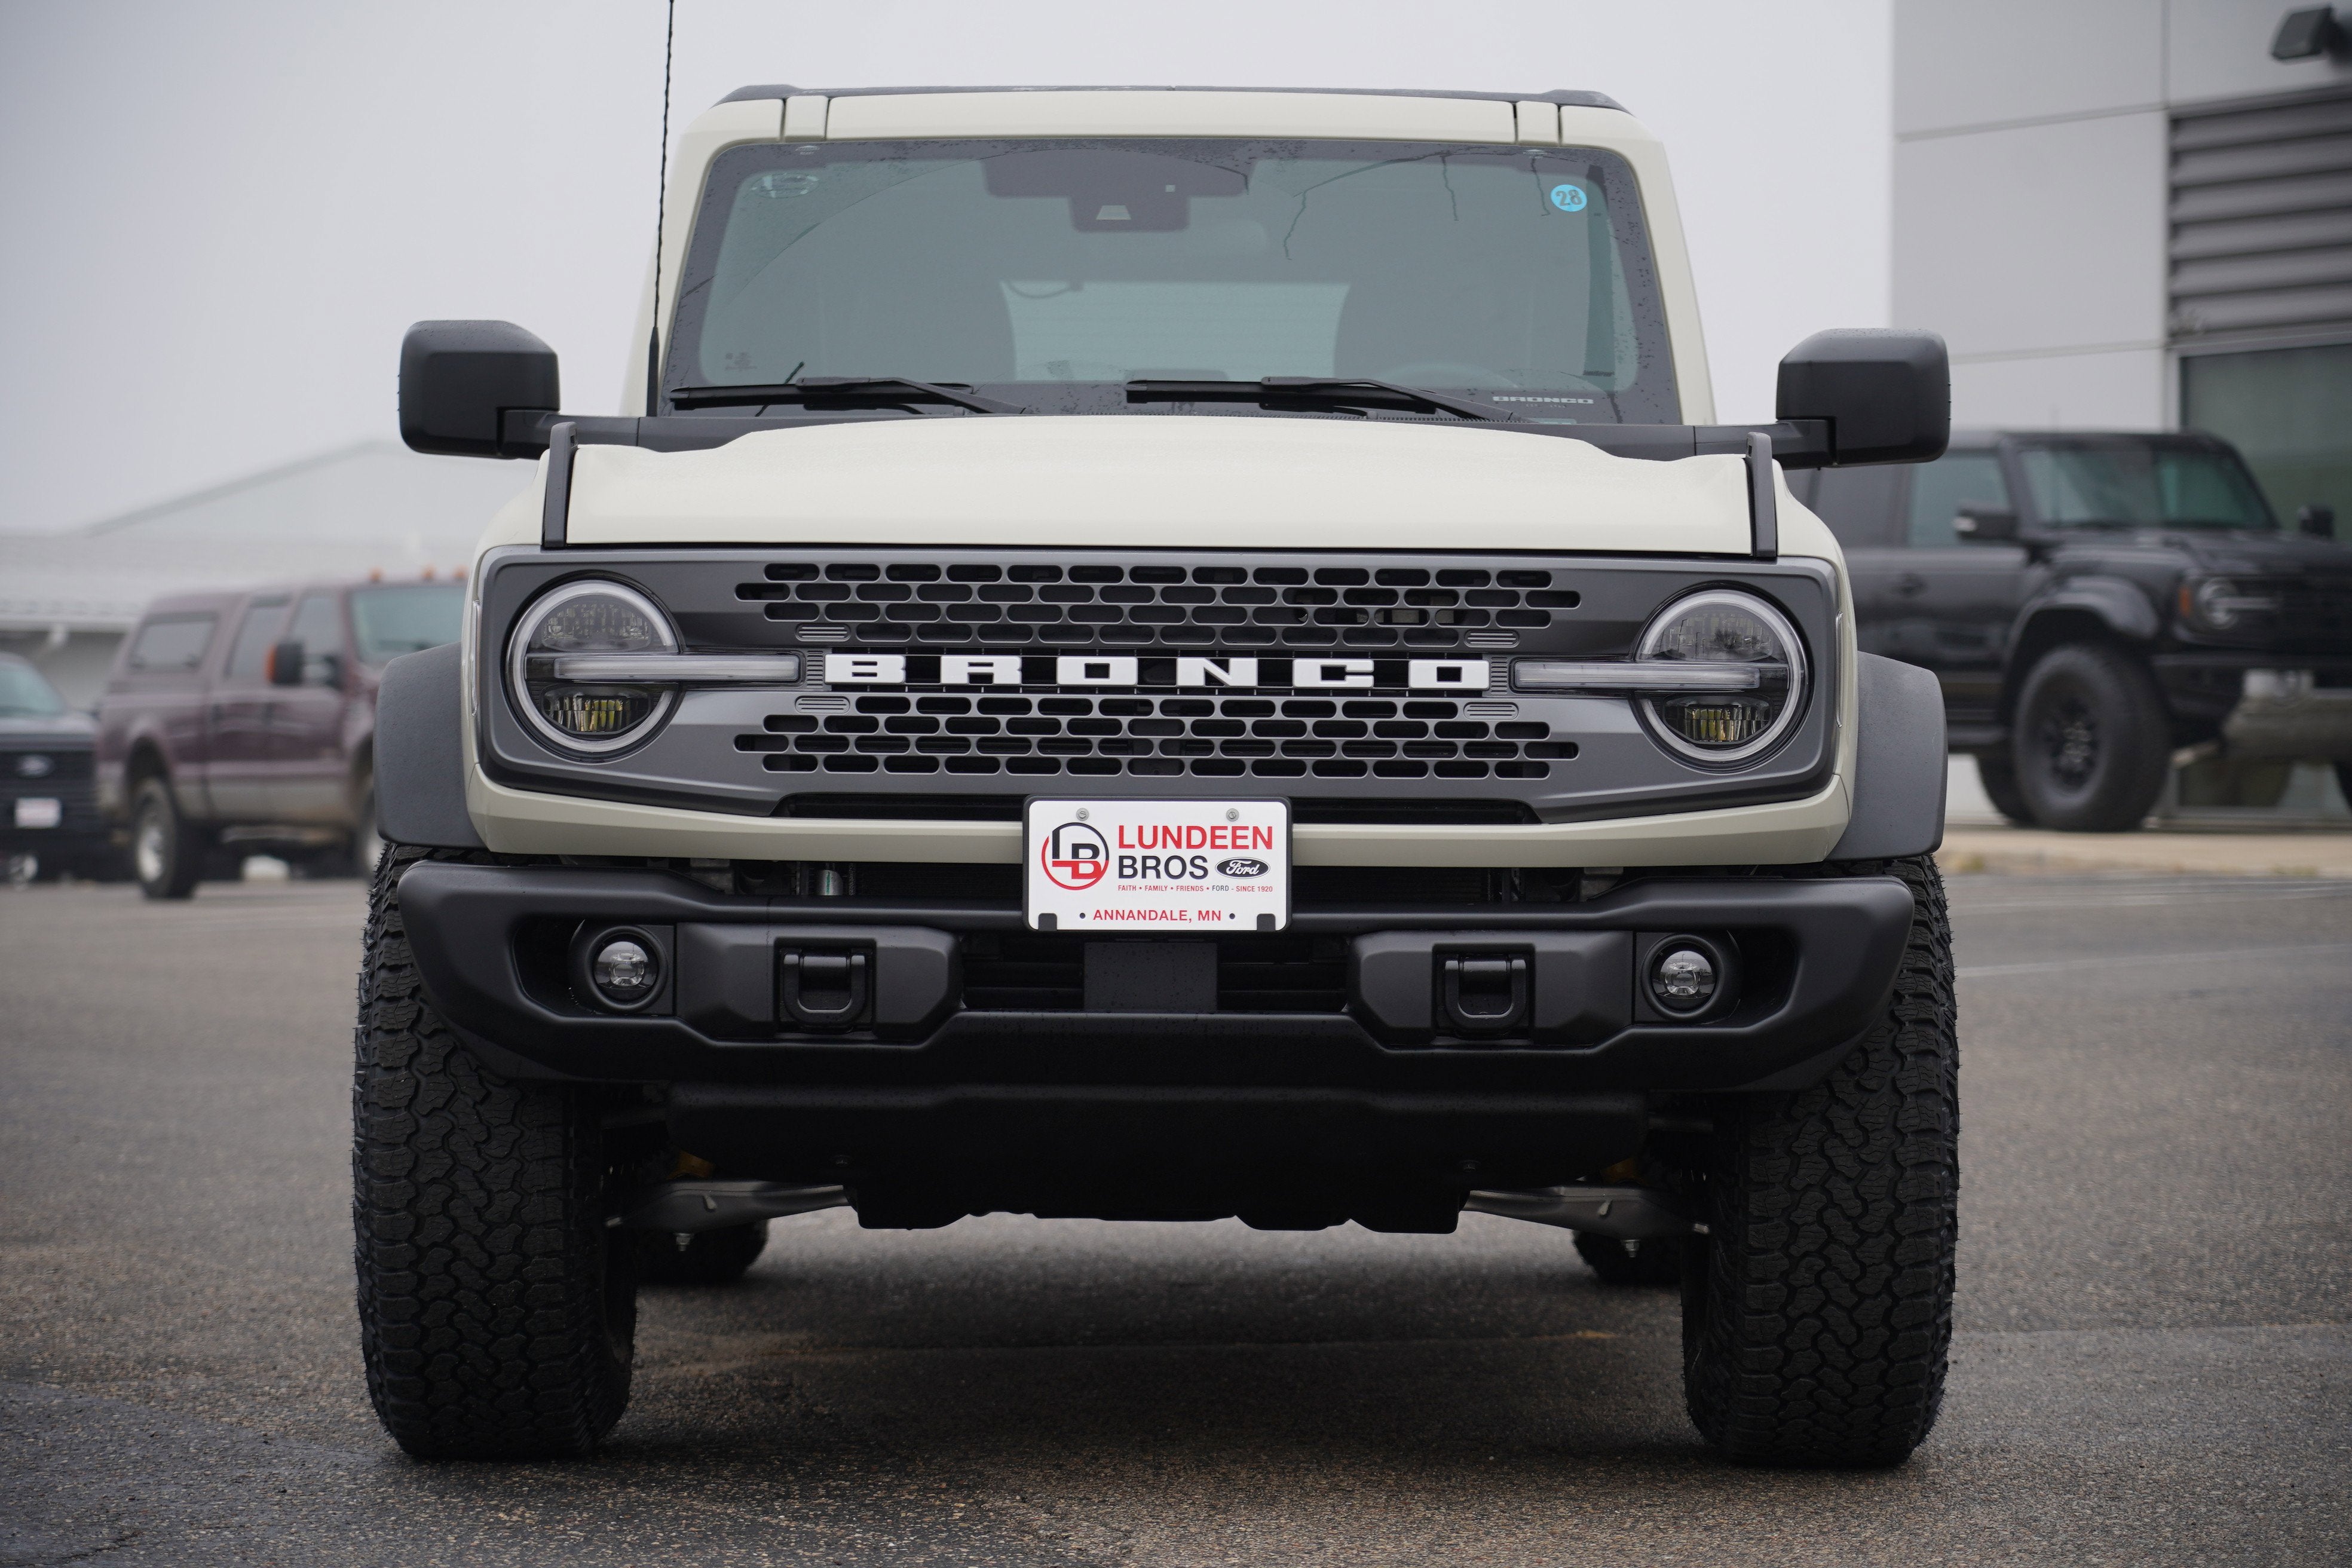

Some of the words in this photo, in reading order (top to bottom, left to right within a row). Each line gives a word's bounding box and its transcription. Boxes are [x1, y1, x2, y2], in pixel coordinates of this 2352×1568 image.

[1555, 189, 1583, 206] 28
[825, 654, 1490, 690] BRONCO
[1118, 825, 1273, 850] LUNDEEN
[1118, 855, 1209, 880] BROS
[1093, 909, 1192, 923] ANNANDALE,
[1198, 910, 1221, 921] MN
